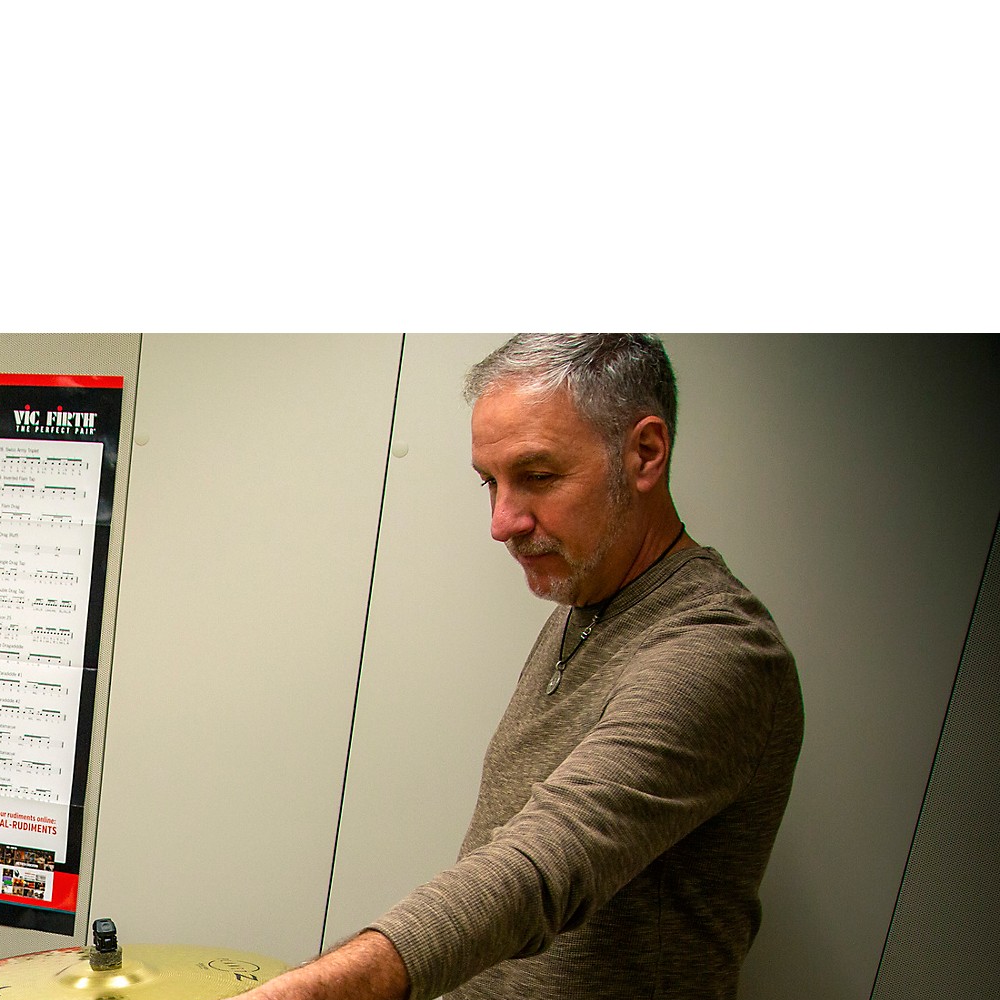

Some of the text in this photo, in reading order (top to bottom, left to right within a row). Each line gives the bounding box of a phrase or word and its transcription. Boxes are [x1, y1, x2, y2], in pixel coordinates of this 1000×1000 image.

[14, 404, 98, 428] VIC FIRTH
[34, 426, 71, 434] PERFECT
[7, 811, 35, 820] rudiments
[36, 815, 56, 823] online:
